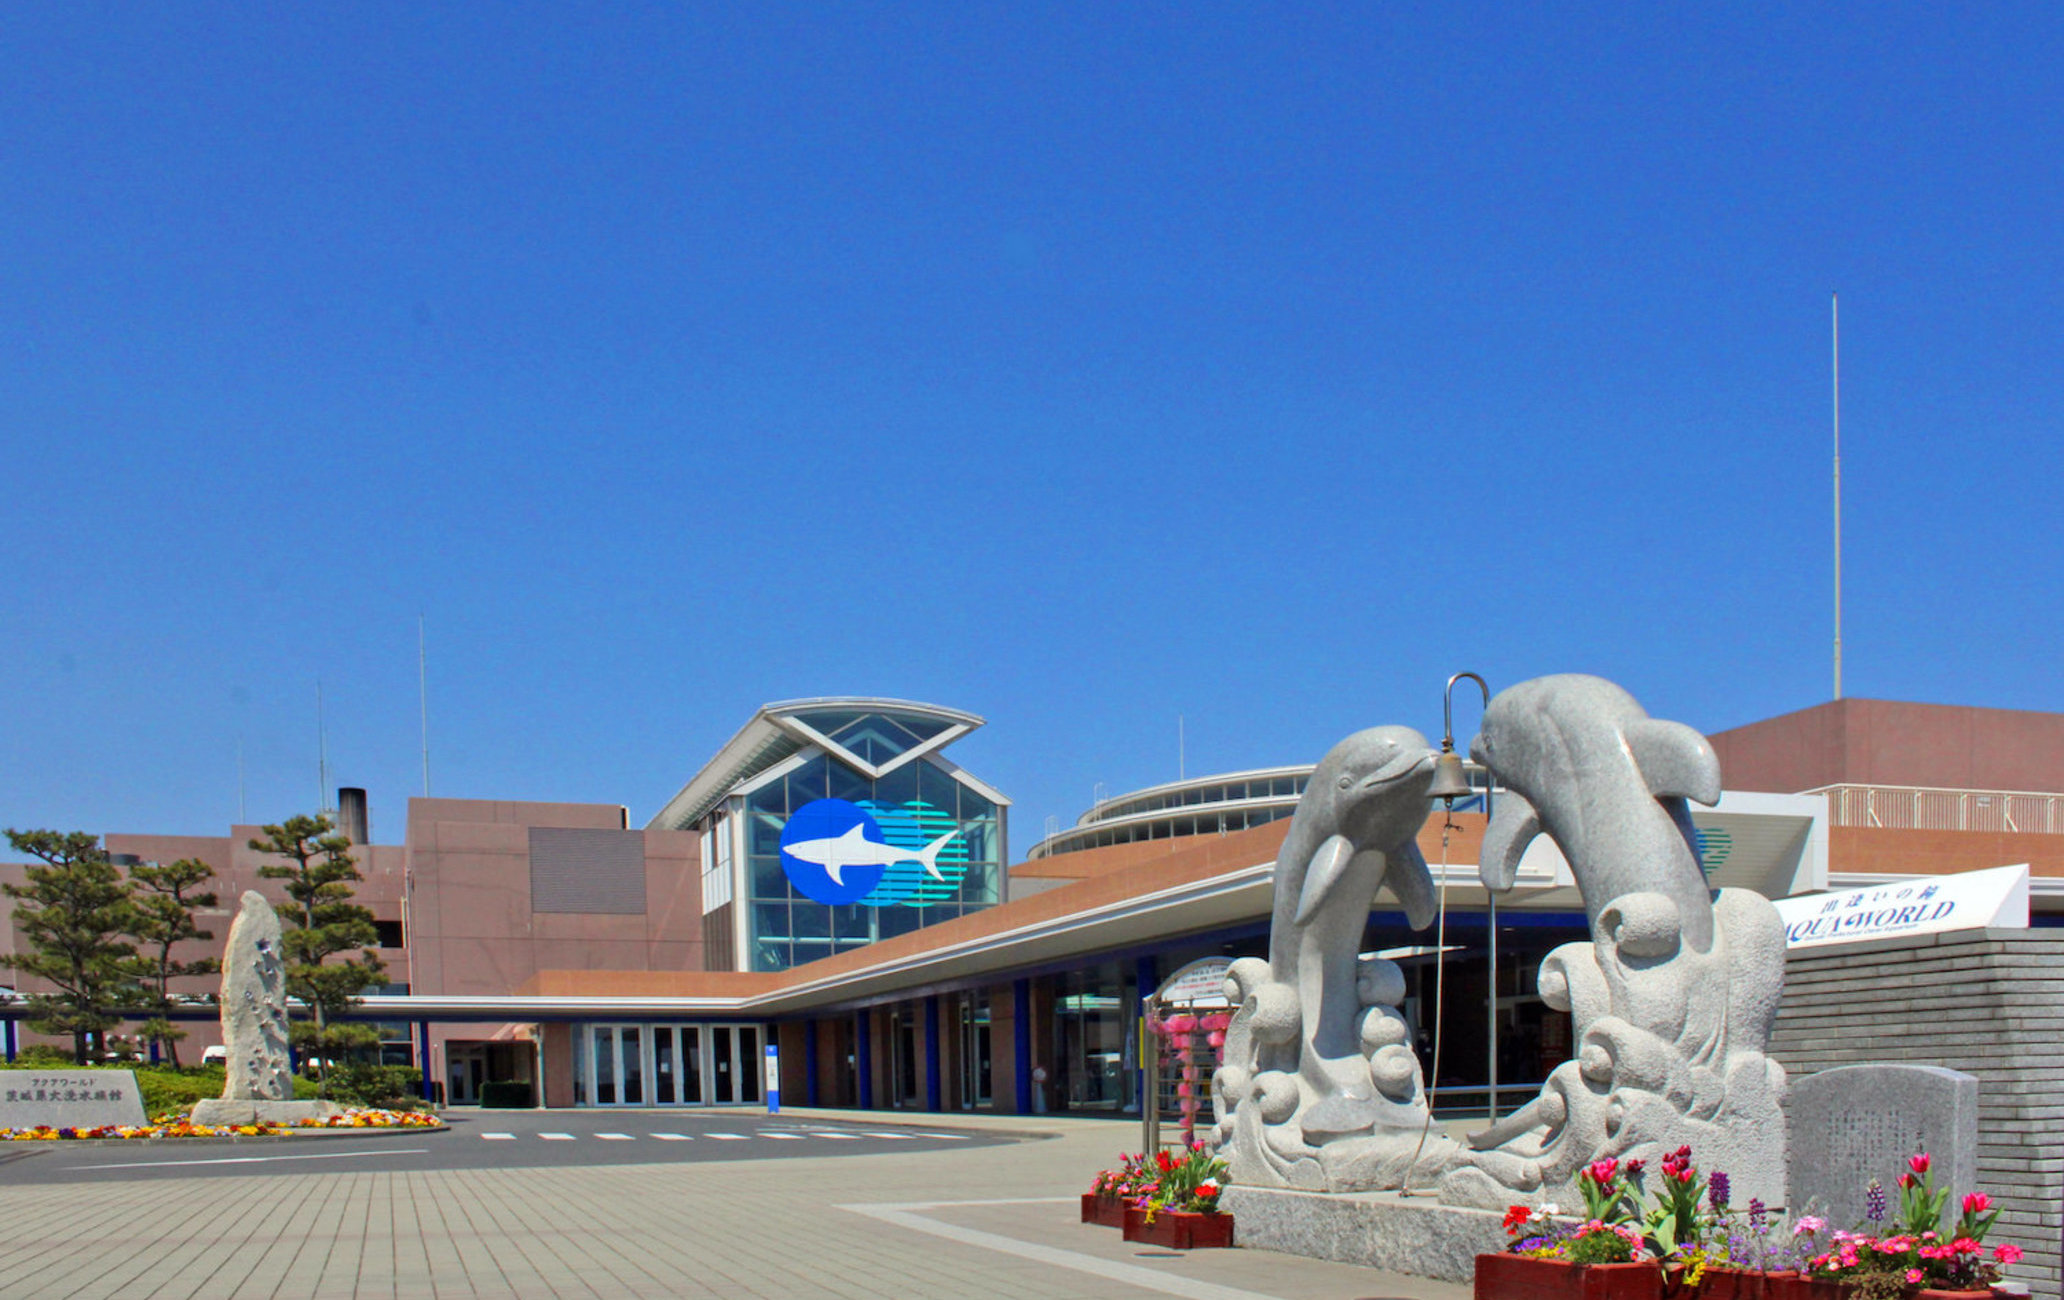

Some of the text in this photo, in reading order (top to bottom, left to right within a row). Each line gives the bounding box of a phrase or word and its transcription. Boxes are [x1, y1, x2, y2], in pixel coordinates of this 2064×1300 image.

[1845, 901, 1955, 927] WORLD
[32, 1078, 97, 1087] アクアワールド
